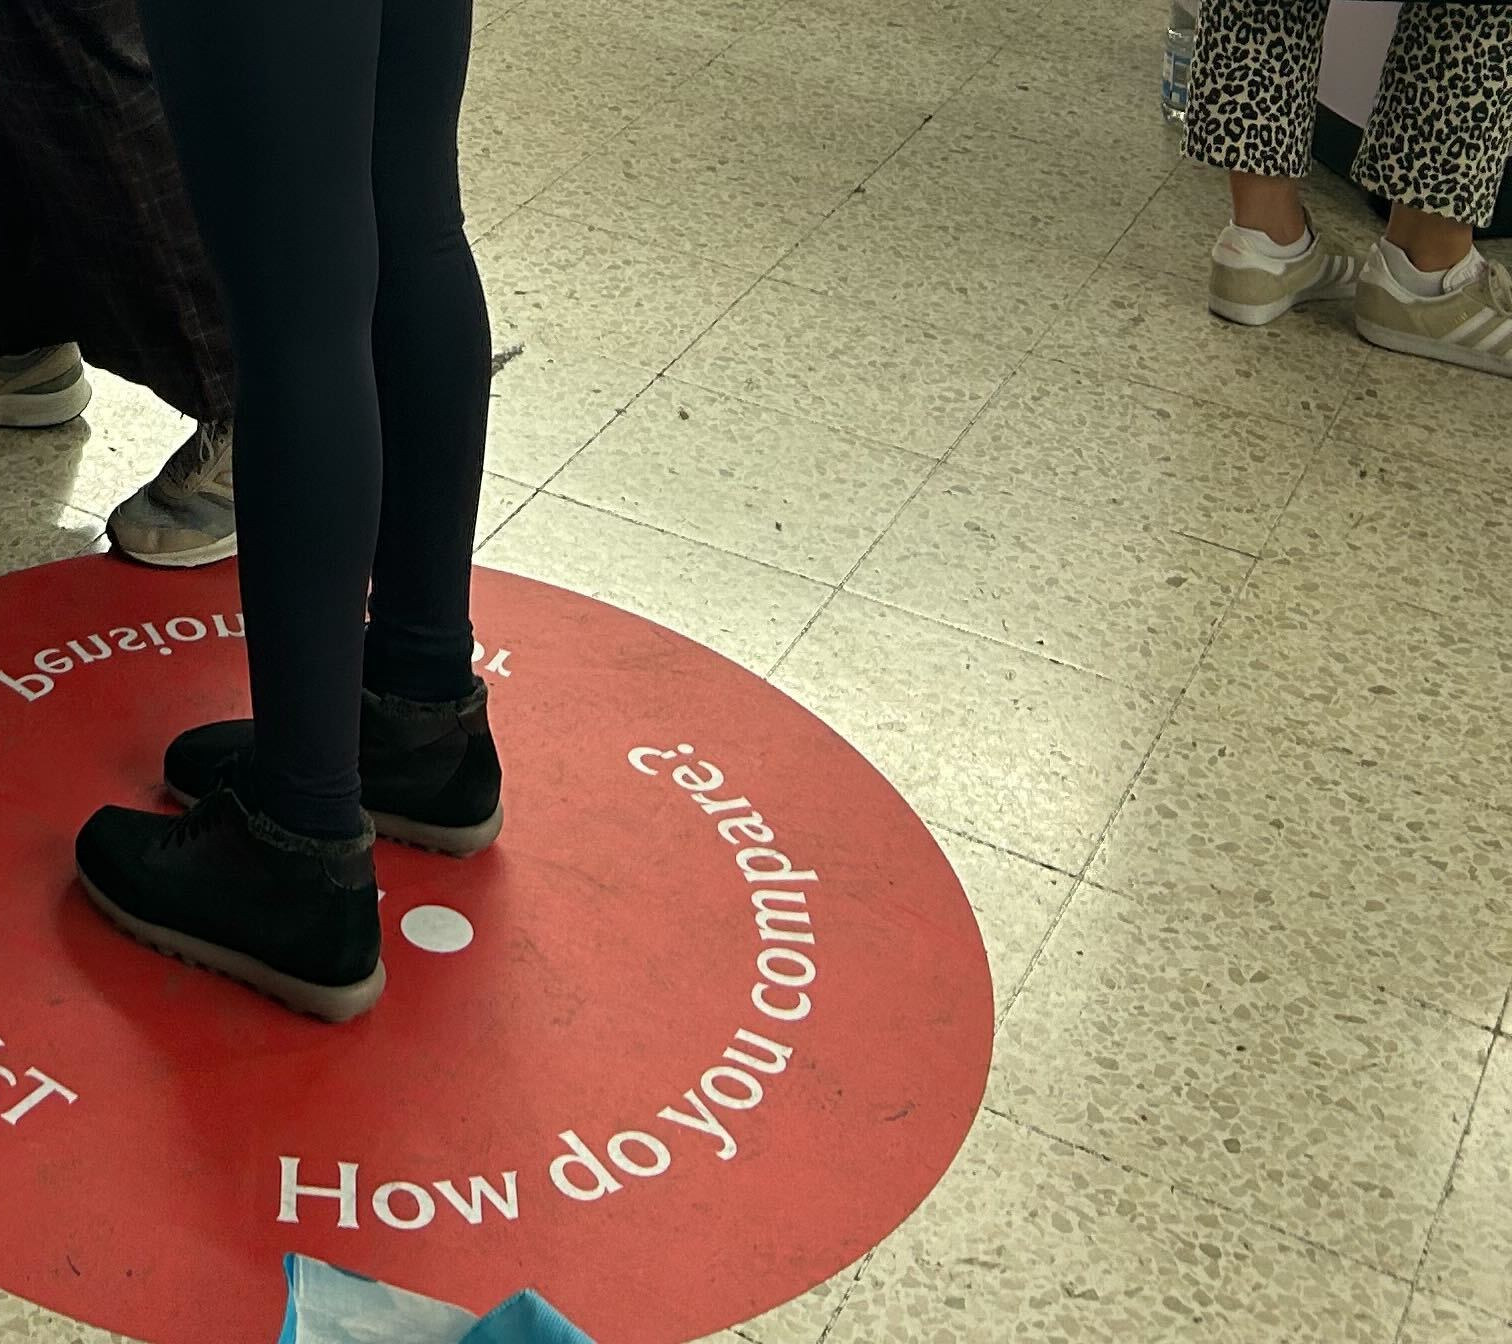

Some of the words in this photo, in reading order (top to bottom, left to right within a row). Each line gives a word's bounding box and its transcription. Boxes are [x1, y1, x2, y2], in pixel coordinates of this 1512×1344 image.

[627, 743, 820, 1022] compare?
[657, 1027, 794, 1162] you
[277, 1154, 520, 1229] How
[549, 1129, 672, 1202] do
